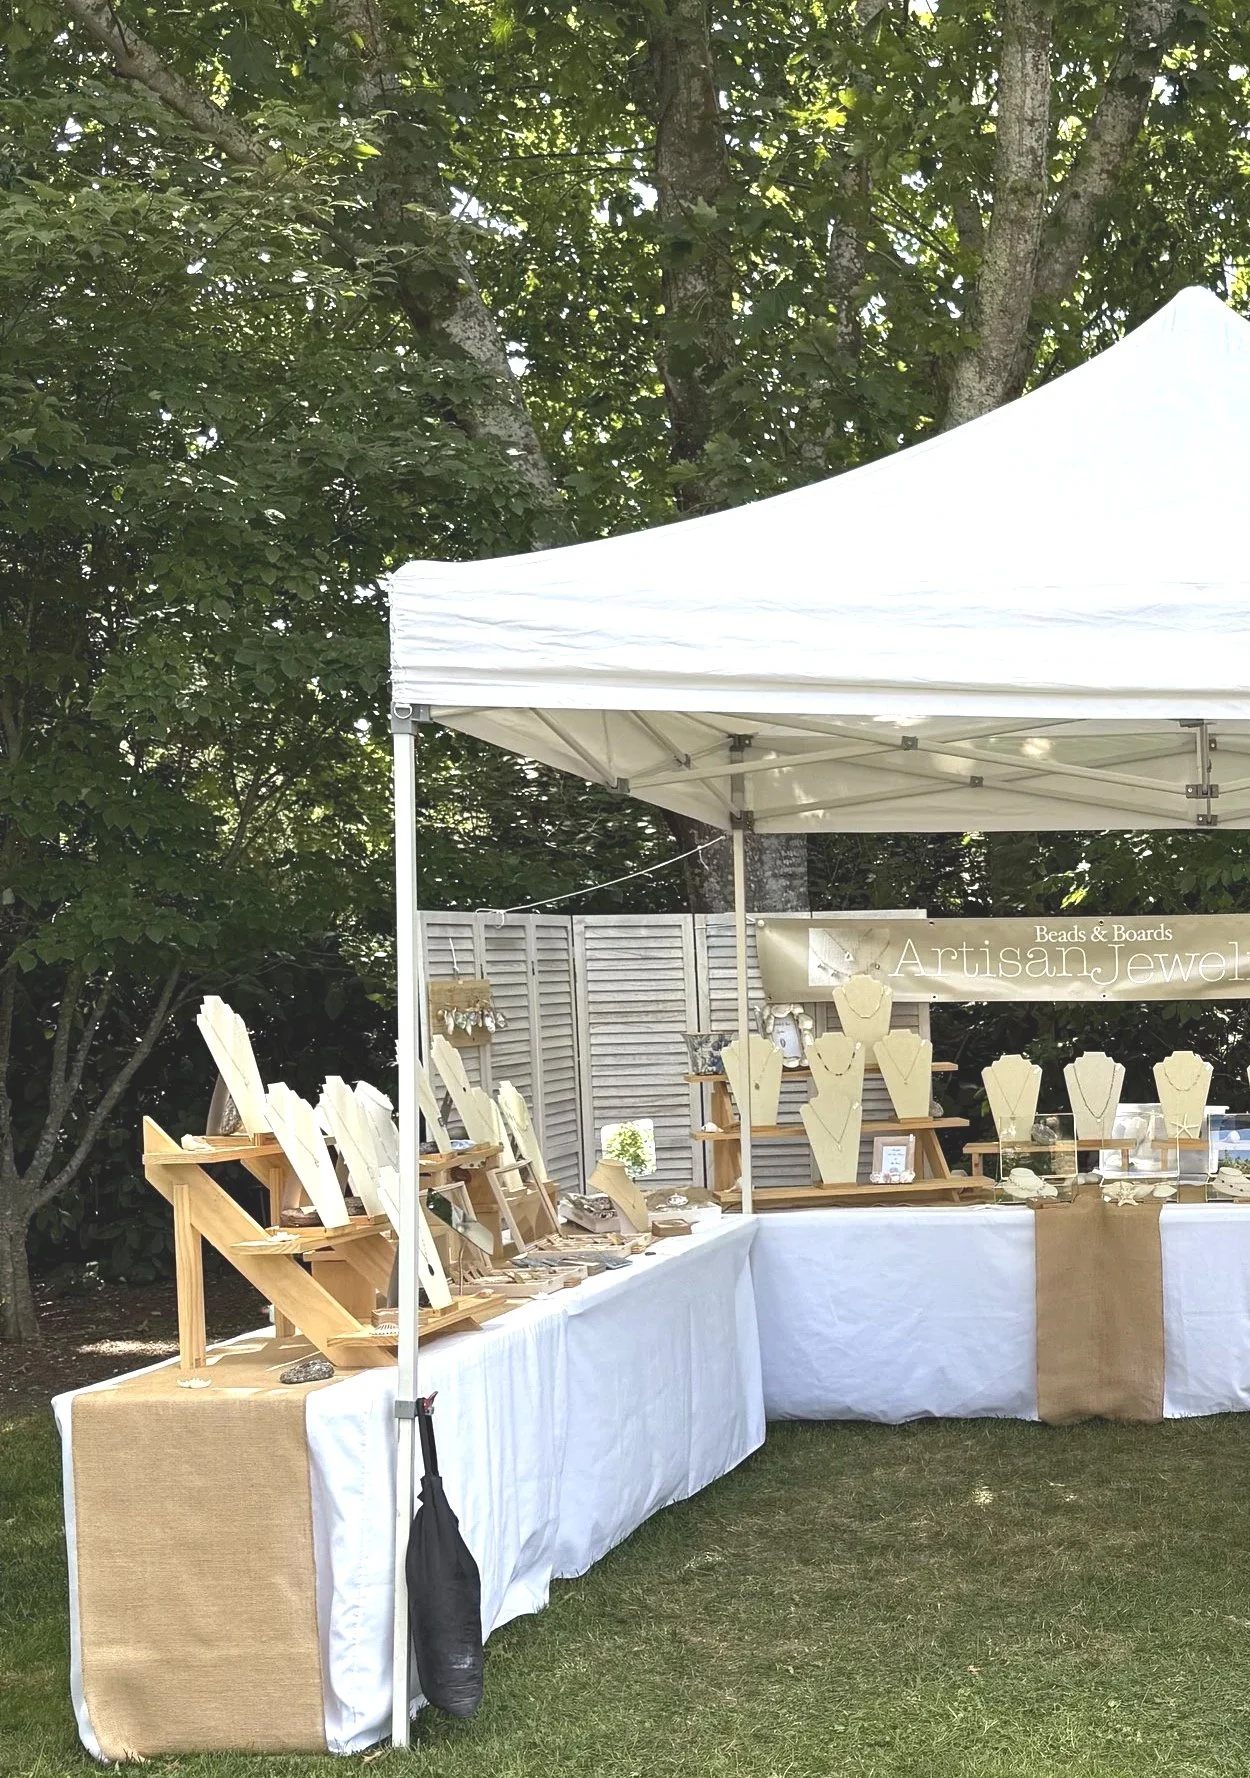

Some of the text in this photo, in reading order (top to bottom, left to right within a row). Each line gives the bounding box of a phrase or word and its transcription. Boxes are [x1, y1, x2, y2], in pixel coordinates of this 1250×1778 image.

[1035, 923, 1173, 943] Beads & Boards
[888, 938, 1091, 978] Artisan
